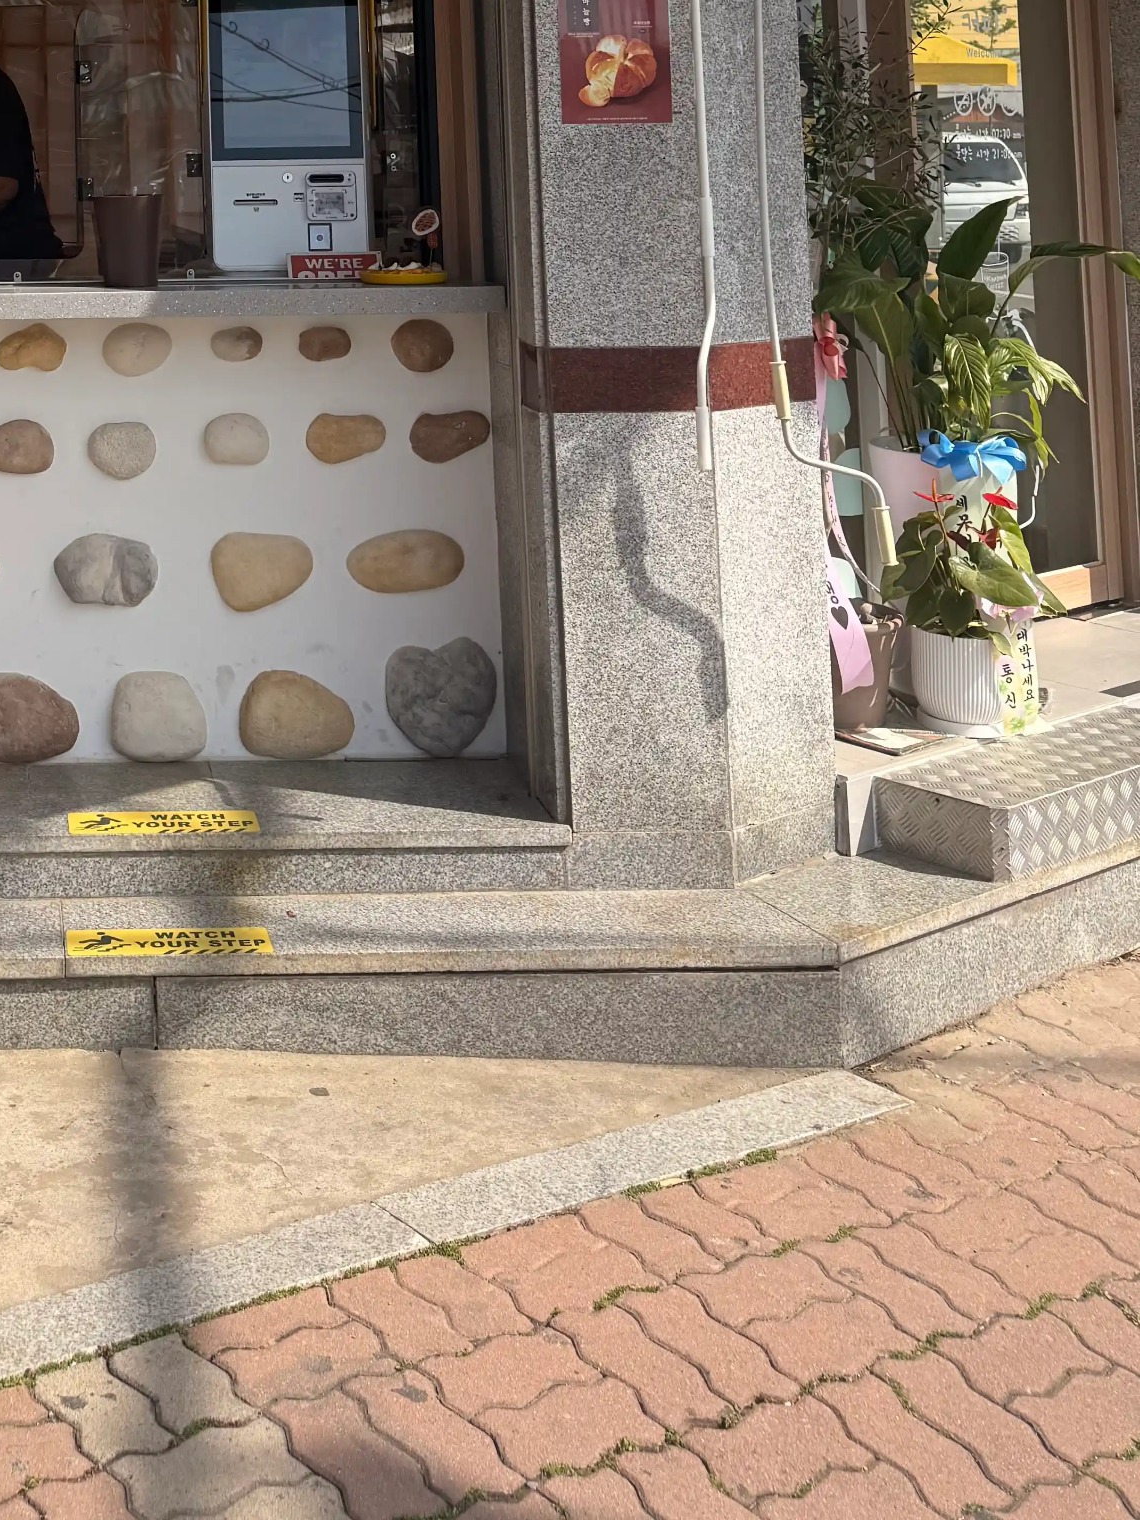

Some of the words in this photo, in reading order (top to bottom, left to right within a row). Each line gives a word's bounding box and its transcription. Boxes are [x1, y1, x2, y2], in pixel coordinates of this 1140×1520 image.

[304, 258, 363, 269] WE'RE
[1016, 629, 1036, 703] 대박나세요
[150, 813, 226, 821] WATCH
[155, 931, 236, 939] WATCH
[134, 940, 197, 948] YOUR
[205, 939, 266, 947] STEP
